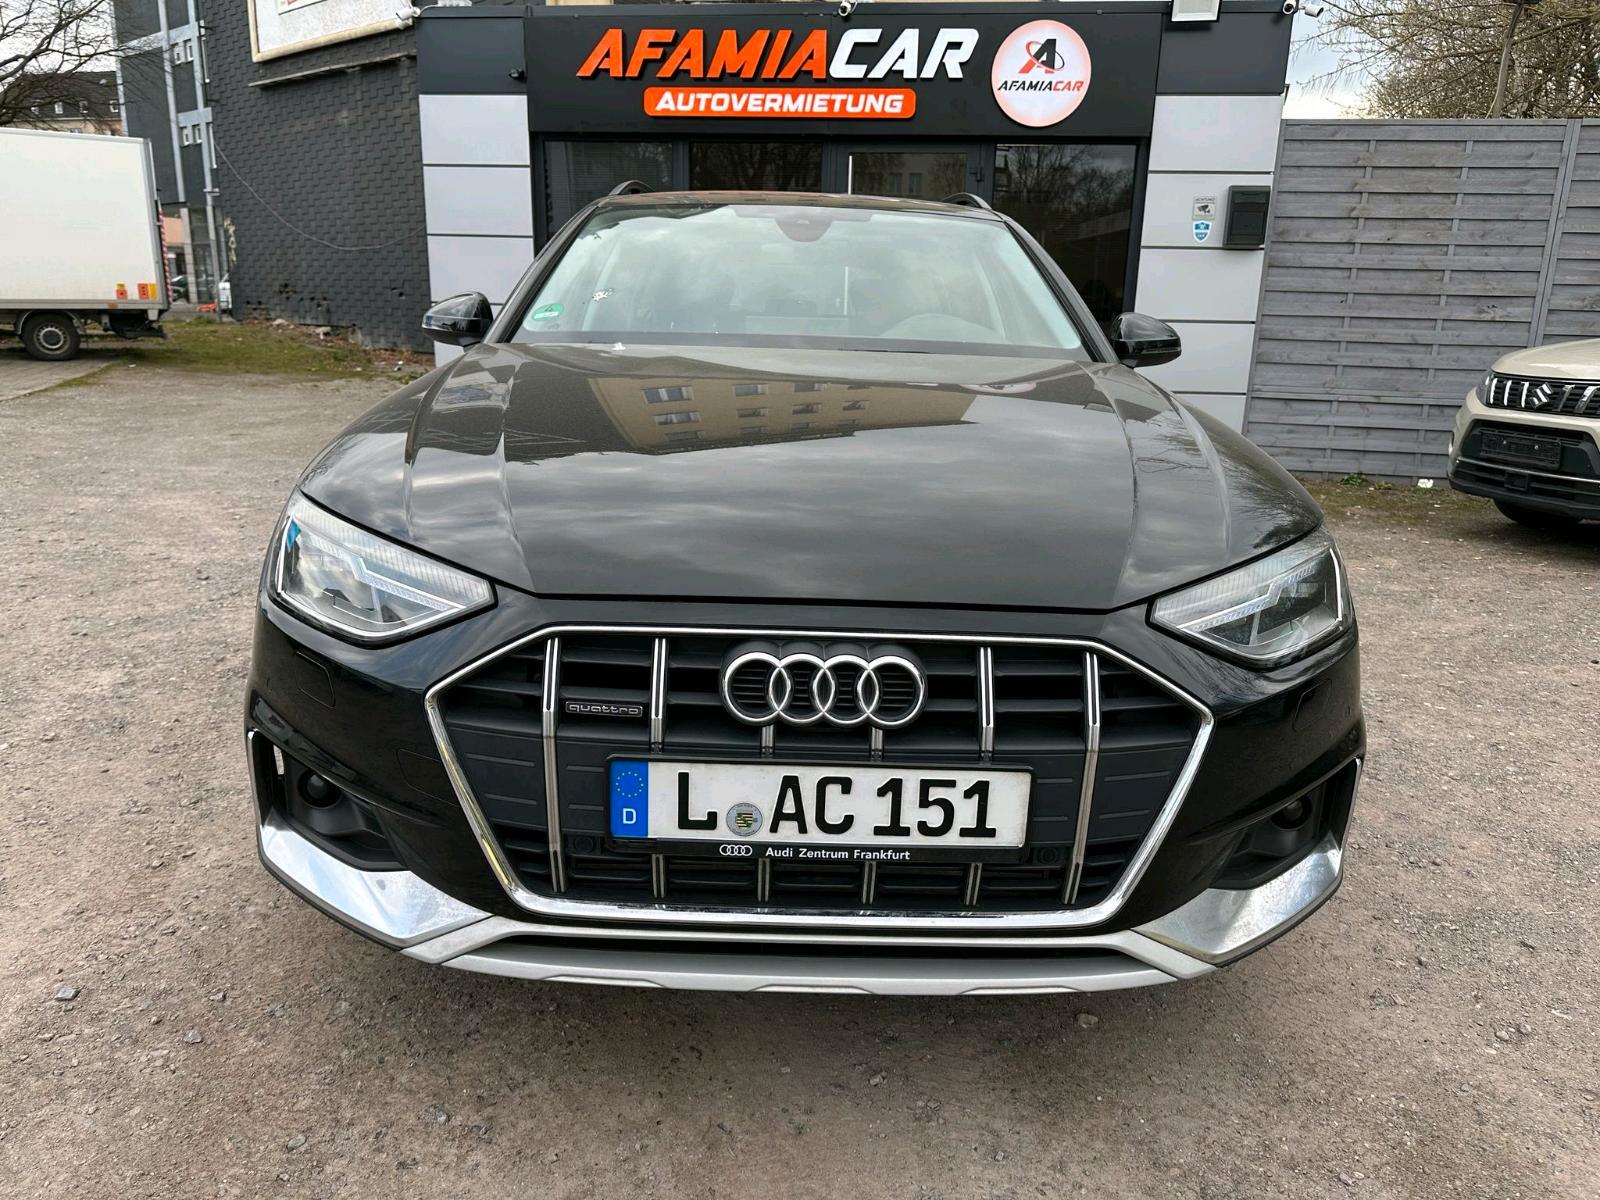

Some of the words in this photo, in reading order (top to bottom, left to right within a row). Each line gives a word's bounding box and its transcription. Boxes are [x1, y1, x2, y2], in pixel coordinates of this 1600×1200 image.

[576, 28, 980, 80] AFAMIACAR
[998, 80, 1084, 91] AFAMIACAR
[655, 91, 904, 113] AUTOVERMIETUNG
[569, 704, 639, 714] quattro
[677, 772, 717, 830] L
[769, 775, 854, 834] AC
[873, 778, 997, 838] 151
[622, 808, 637, 824] D
[765, 847, 793, 857] Audi
[799, 848, 849, 858] Zentrum
[853, 849, 910, 860] Frankfurt
